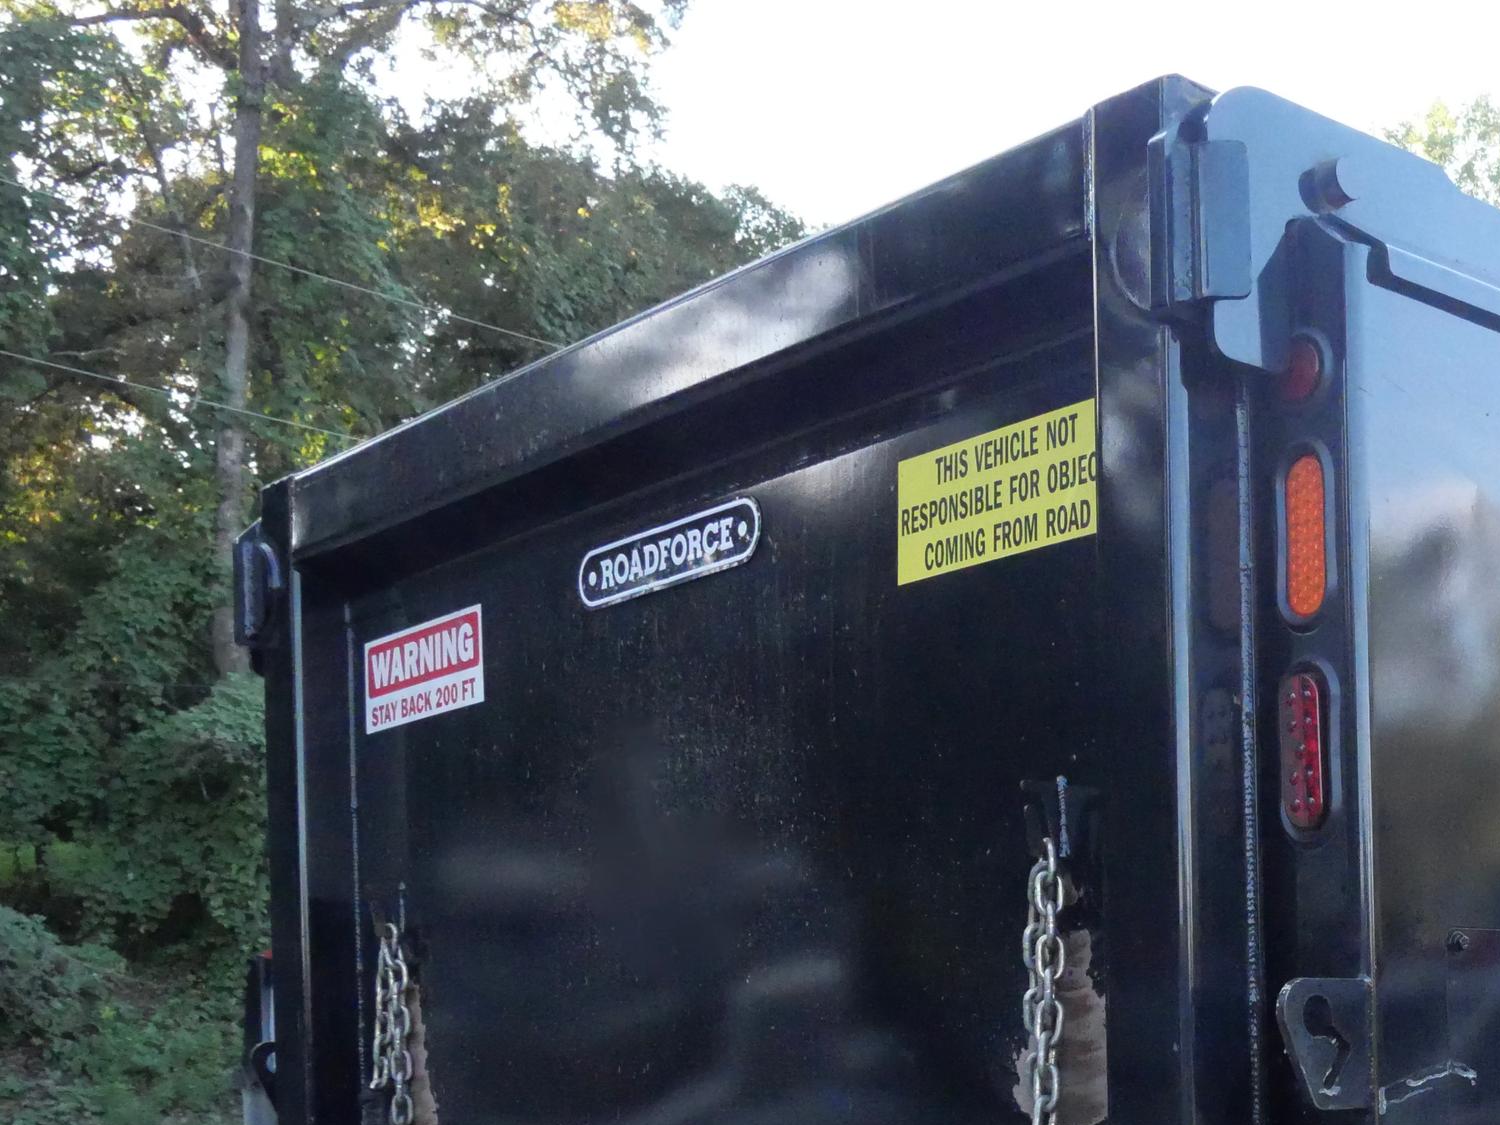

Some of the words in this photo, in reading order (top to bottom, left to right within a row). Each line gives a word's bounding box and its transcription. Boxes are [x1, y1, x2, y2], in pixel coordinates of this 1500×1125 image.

[936, 448, 968, 485] THIS
[975, 425, 1039, 472] VEHICLE
[1046, 413, 1078, 451] NOT
[901, 480, 1003, 536] RESPONSIBLE
[1009, 469, 1040, 505] FOR
[924, 528, 985, 570] COMING
[993, 513, 1038, 552] FROM
[1046, 499, 1091, 538] ROAD
[601, 517, 734, 589] ROADFORCE
[372, 623, 474, 689] WARNING
[371, 701, 398, 727] STAY
[401, 691, 432, 718] BACK
[436, 683, 458, 708] 200
[462, 678, 475, 700] FT
